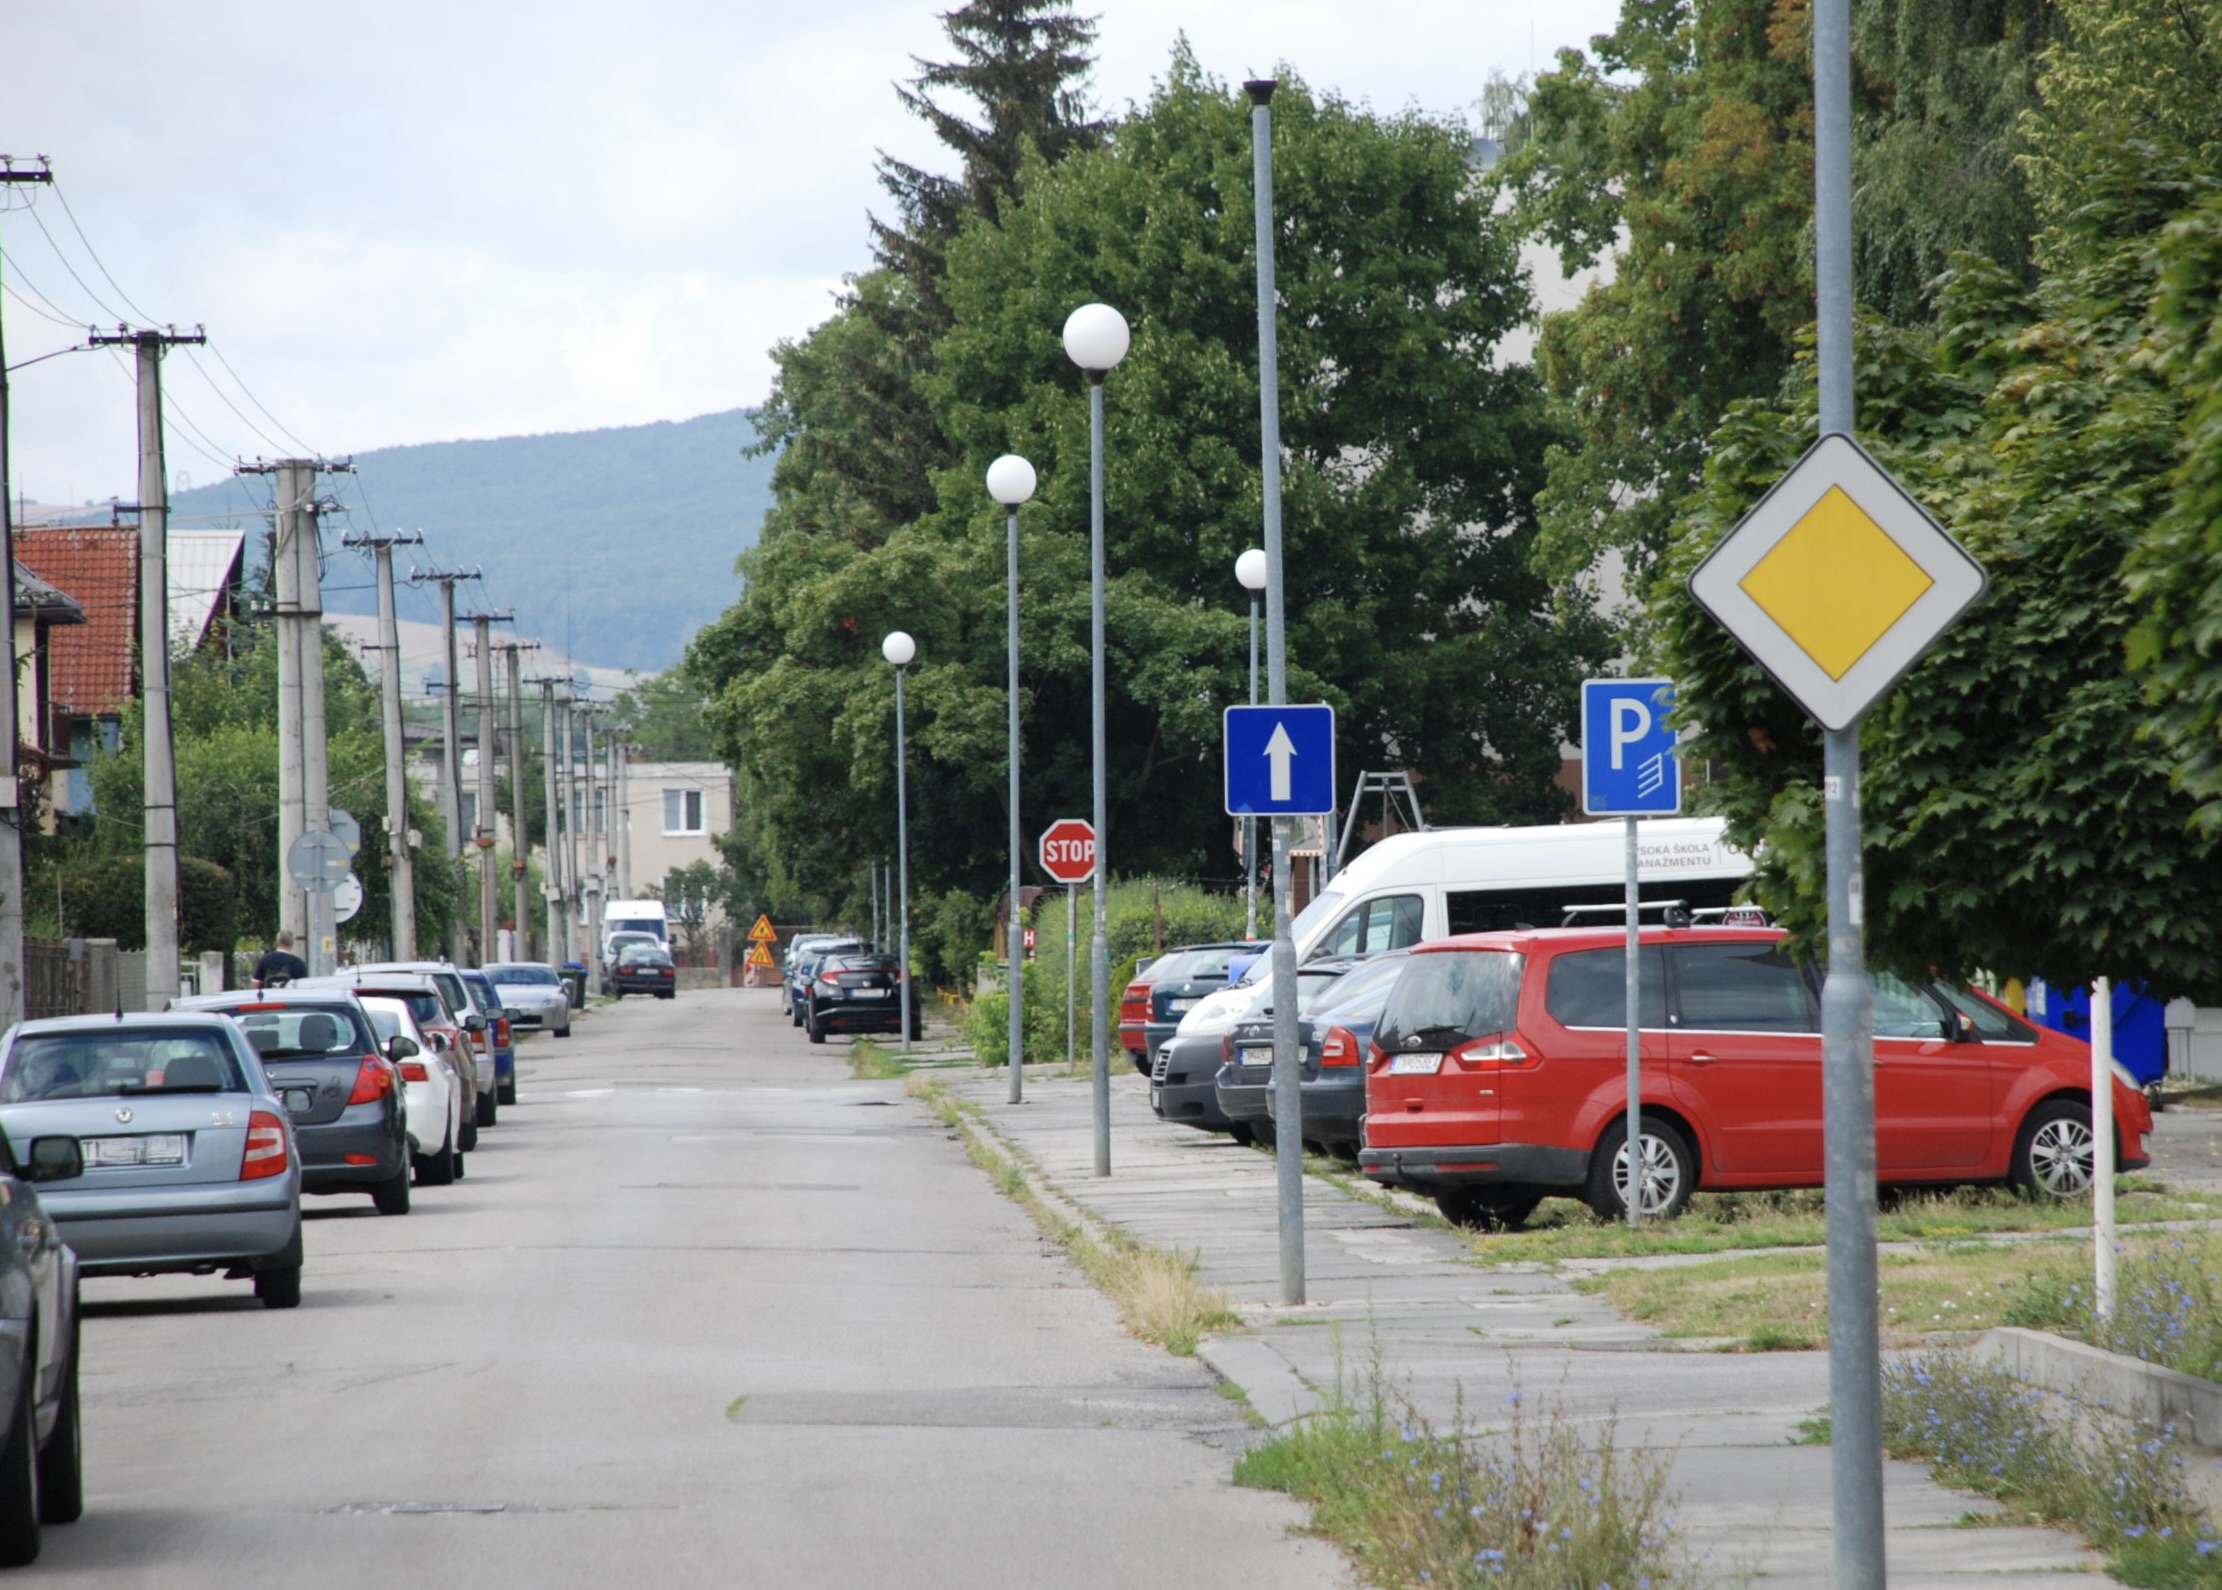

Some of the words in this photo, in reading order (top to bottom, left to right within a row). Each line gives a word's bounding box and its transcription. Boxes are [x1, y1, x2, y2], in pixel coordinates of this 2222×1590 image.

[1610, 698, 1651, 770] P
[1046, 839, 1095, 863] STOP
[1673, 842, 1710, 855] ŠKOLA
[1637, 856, 1712, 869] ANAŽMENTU
[1024, 930, 1034, 946] H
